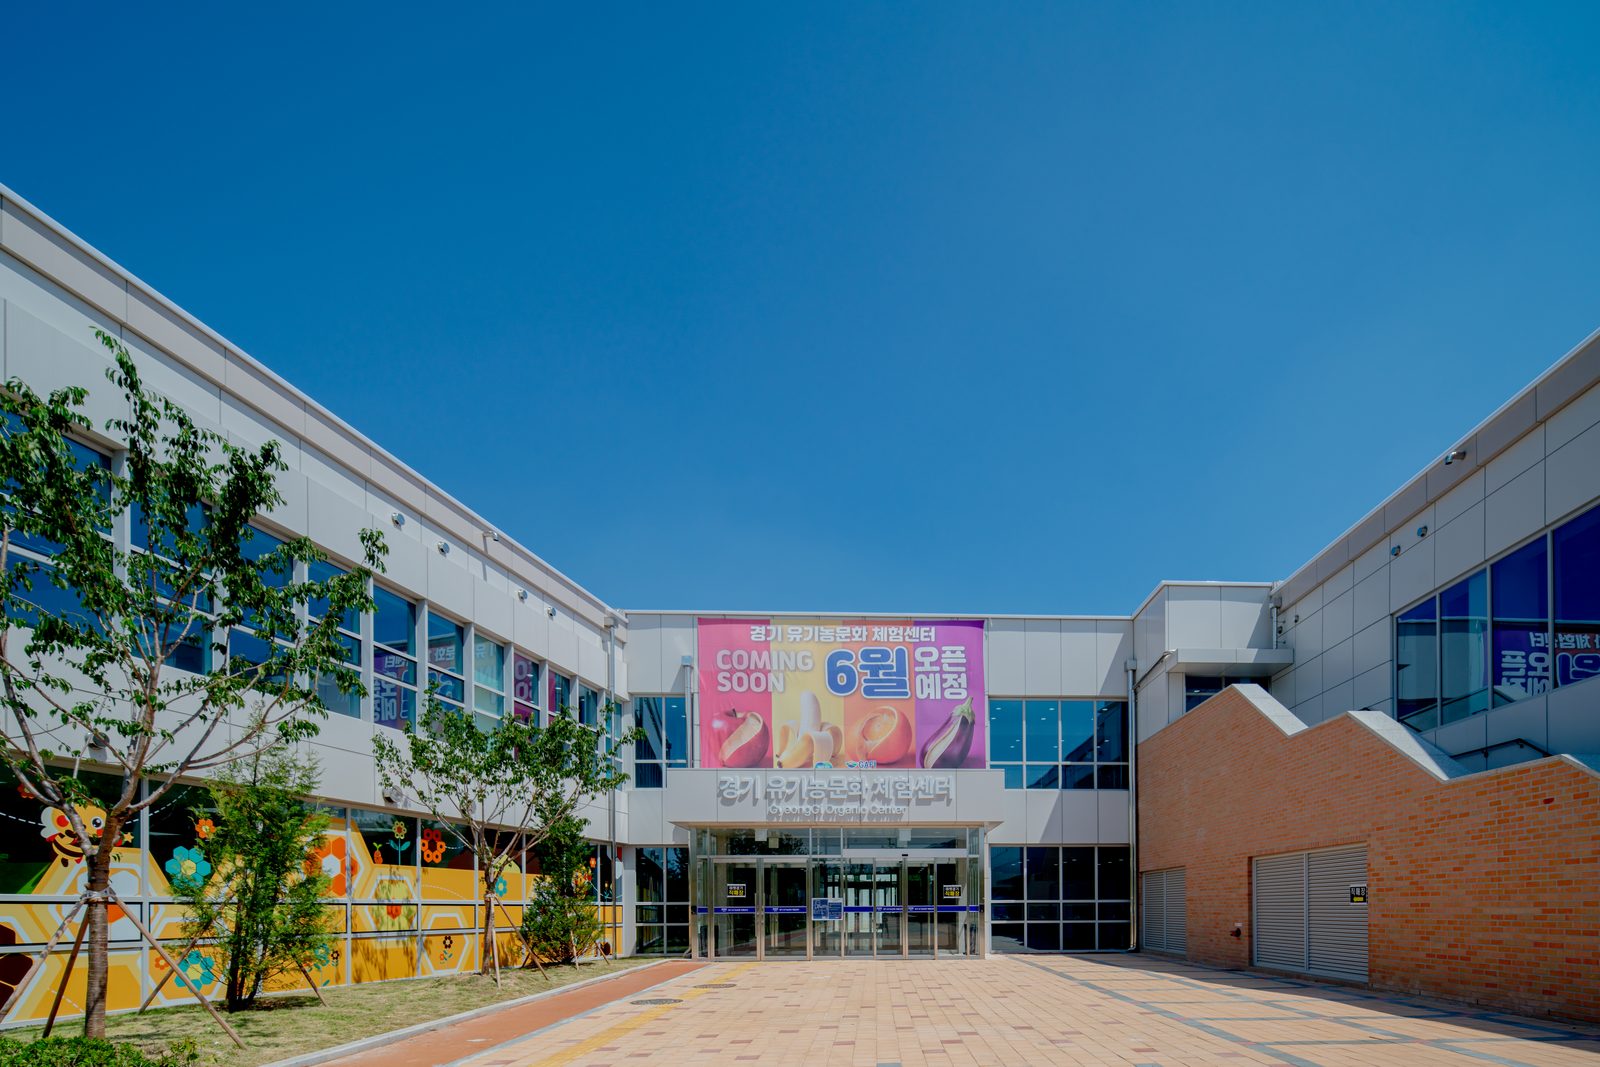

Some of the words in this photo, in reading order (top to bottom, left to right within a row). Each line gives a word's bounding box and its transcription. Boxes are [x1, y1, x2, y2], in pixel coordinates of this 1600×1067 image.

[750, 625, 782, 643] 경기
[787, 625, 868, 643] 유기농문화
[872, 625, 936, 643] 체험센터
[716, 649, 813, 671] COMING
[914, 645, 967, 673] 오픈
[717, 672, 785, 693] SOON
[825, 646, 911, 699] 6월
[915, 673, 968, 700] 예정
[719, 775, 760, 800] 경기
[766, 775, 869, 800] 유기농문화
[873, 775, 953, 800] 체험센터
[826, 804, 867, 817] Organic
[871, 804, 907, 815] Center
